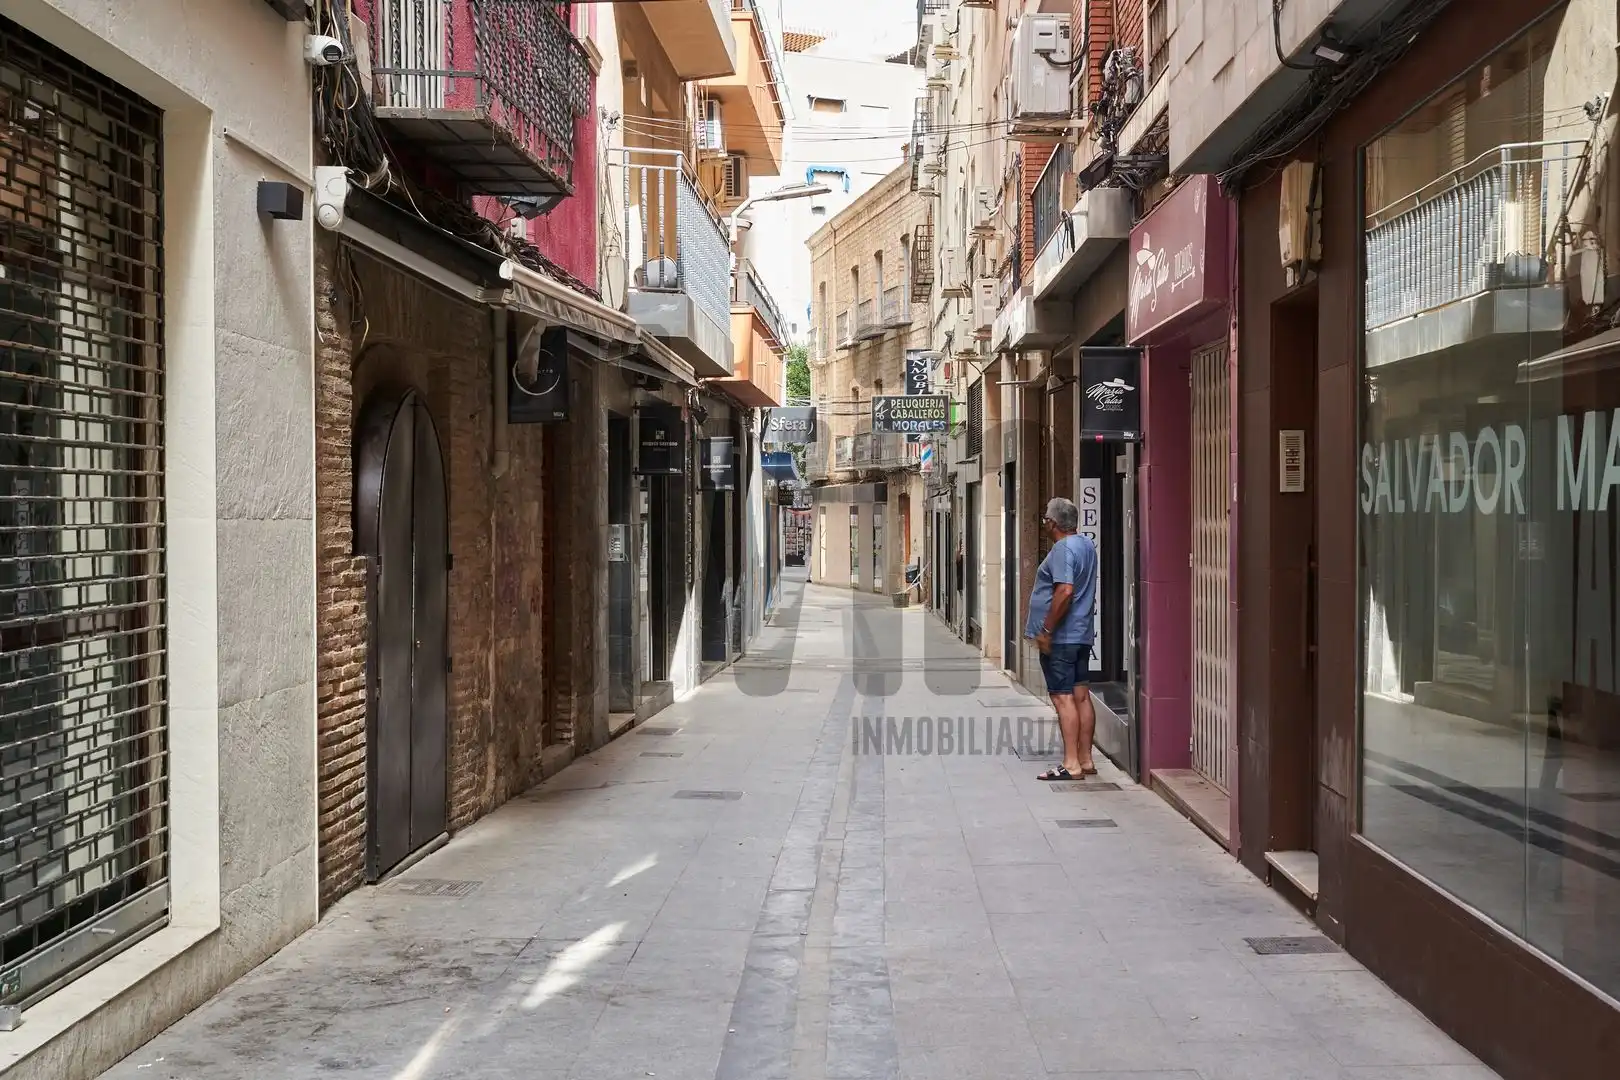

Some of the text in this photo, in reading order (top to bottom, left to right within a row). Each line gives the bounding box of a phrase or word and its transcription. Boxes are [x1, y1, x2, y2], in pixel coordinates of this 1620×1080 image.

[891, 398, 945, 409] PELUQUERIA
[890, 408, 945, 419] CABALLEROS
[892, 420, 946, 431] MORALES
[1361, 425, 1526, 515] SALVADOR
